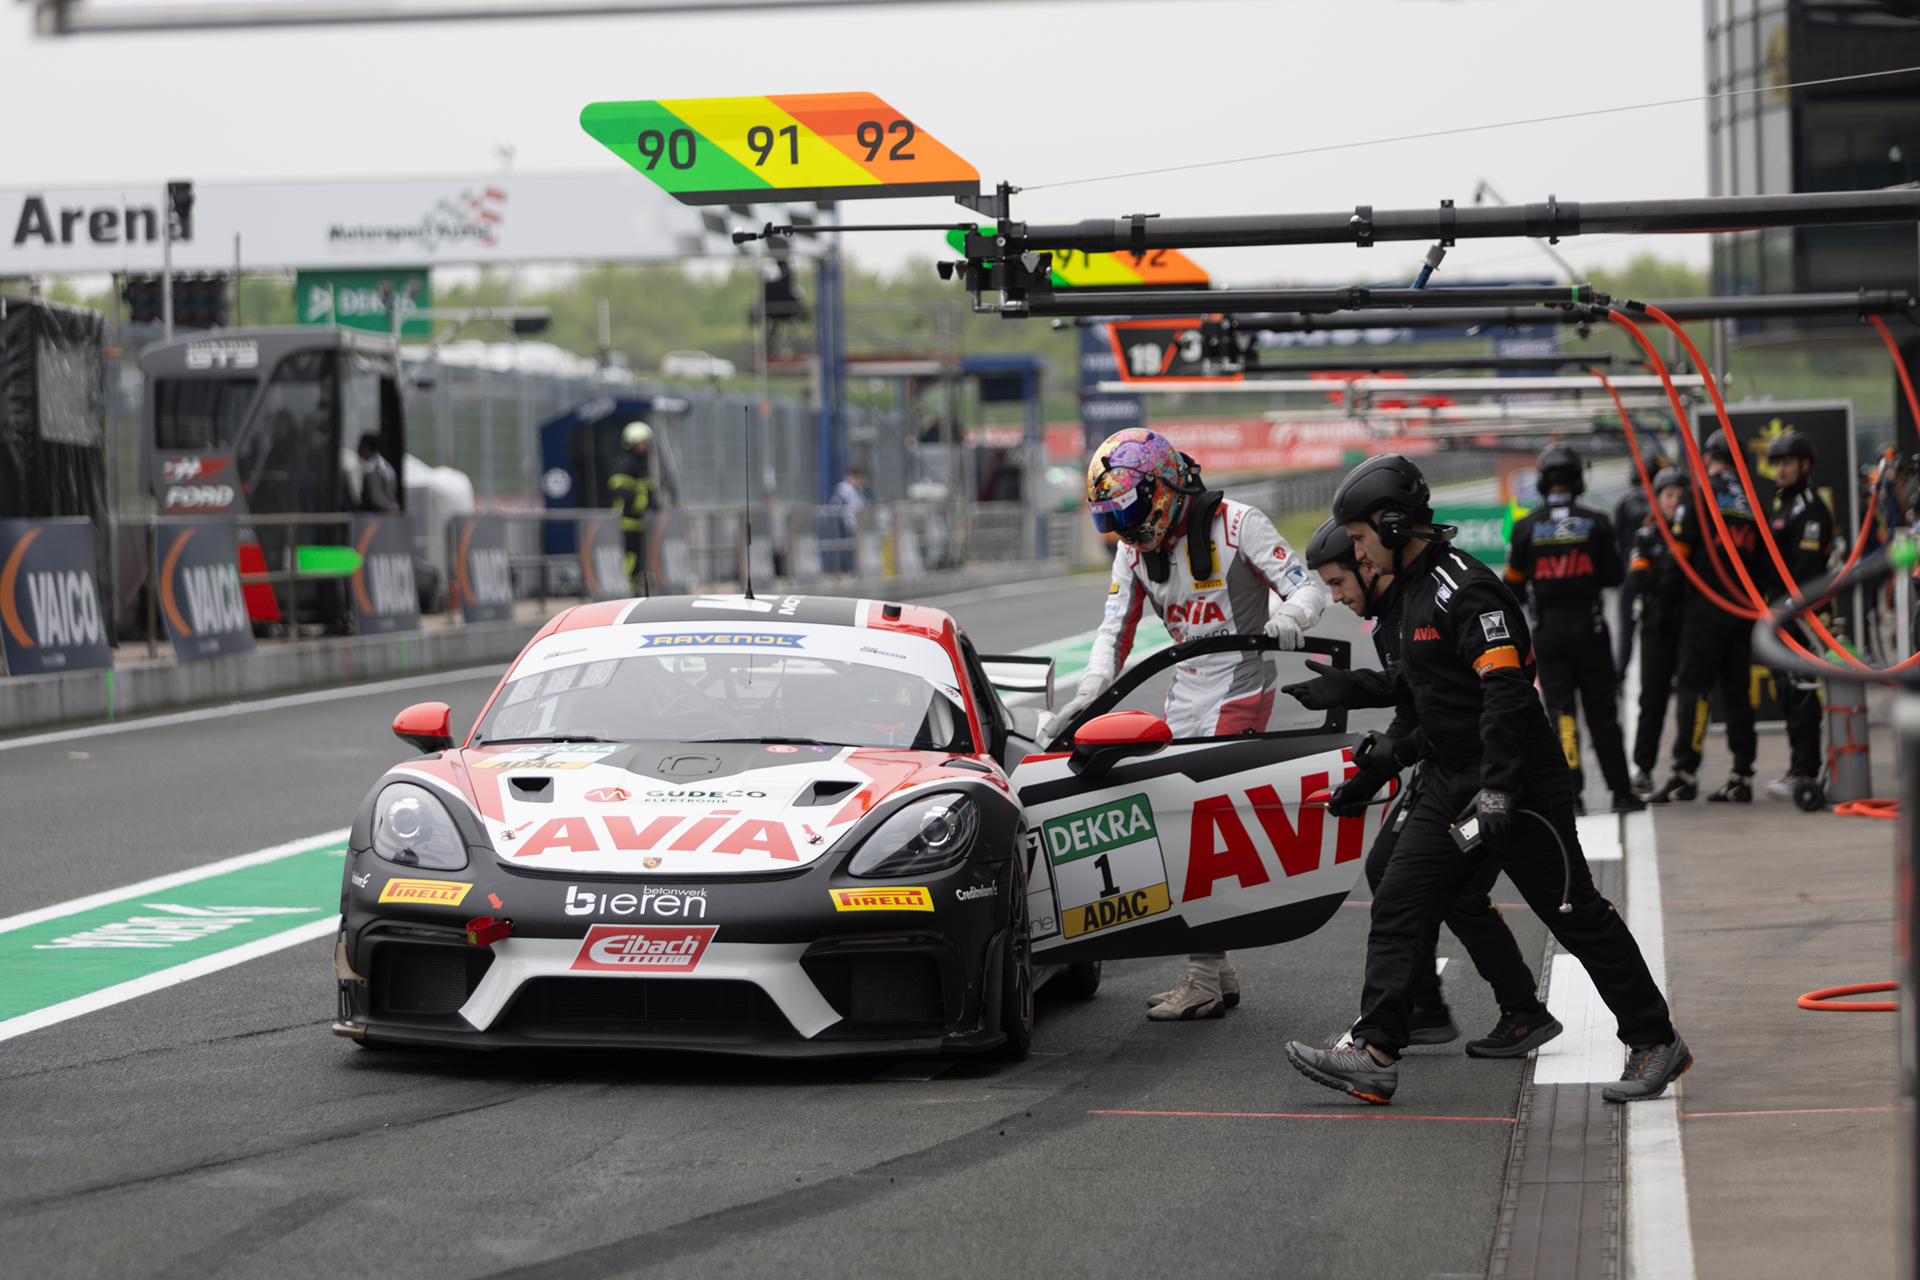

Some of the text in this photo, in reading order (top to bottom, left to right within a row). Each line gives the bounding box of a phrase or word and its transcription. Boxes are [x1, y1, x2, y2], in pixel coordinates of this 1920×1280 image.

[637, 120, 916, 171] 90 91 92
[166, 485, 235, 507] FORD
[1534, 549, 1595, 579] AVIA
[183, 563, 245, 635] VAICO
[1194, 580, 1222, 590] PIRELLI
[27, 570, 99, 646] VAICO
[652, 634, 793, 646] RAVENOL
[1413, 624, 1441, 641] AVIA
[529, 695, 559, 738] 1
[490, 761, 567, 769] ADAC
[526, 752, 558, 761] 1
[646, 790, 767, 798] GUDECO
[513, 809, 801, 862] AVIA
[1048, 803, 1152, 858] DEKRA
[1182, 748, 1398, 903] AVI
[386, 881, 464, 901] PIRELLI
[643, 885, 707, 897] betonwerk
[1093, 853, 1121, 899] 1
[564, 886, 707, 918] bieren
[838, 889, 925, 907] PIRELLI
[1083, 890, 1149, 932] ADAC
[589, 934, 699, 965] Eibach
